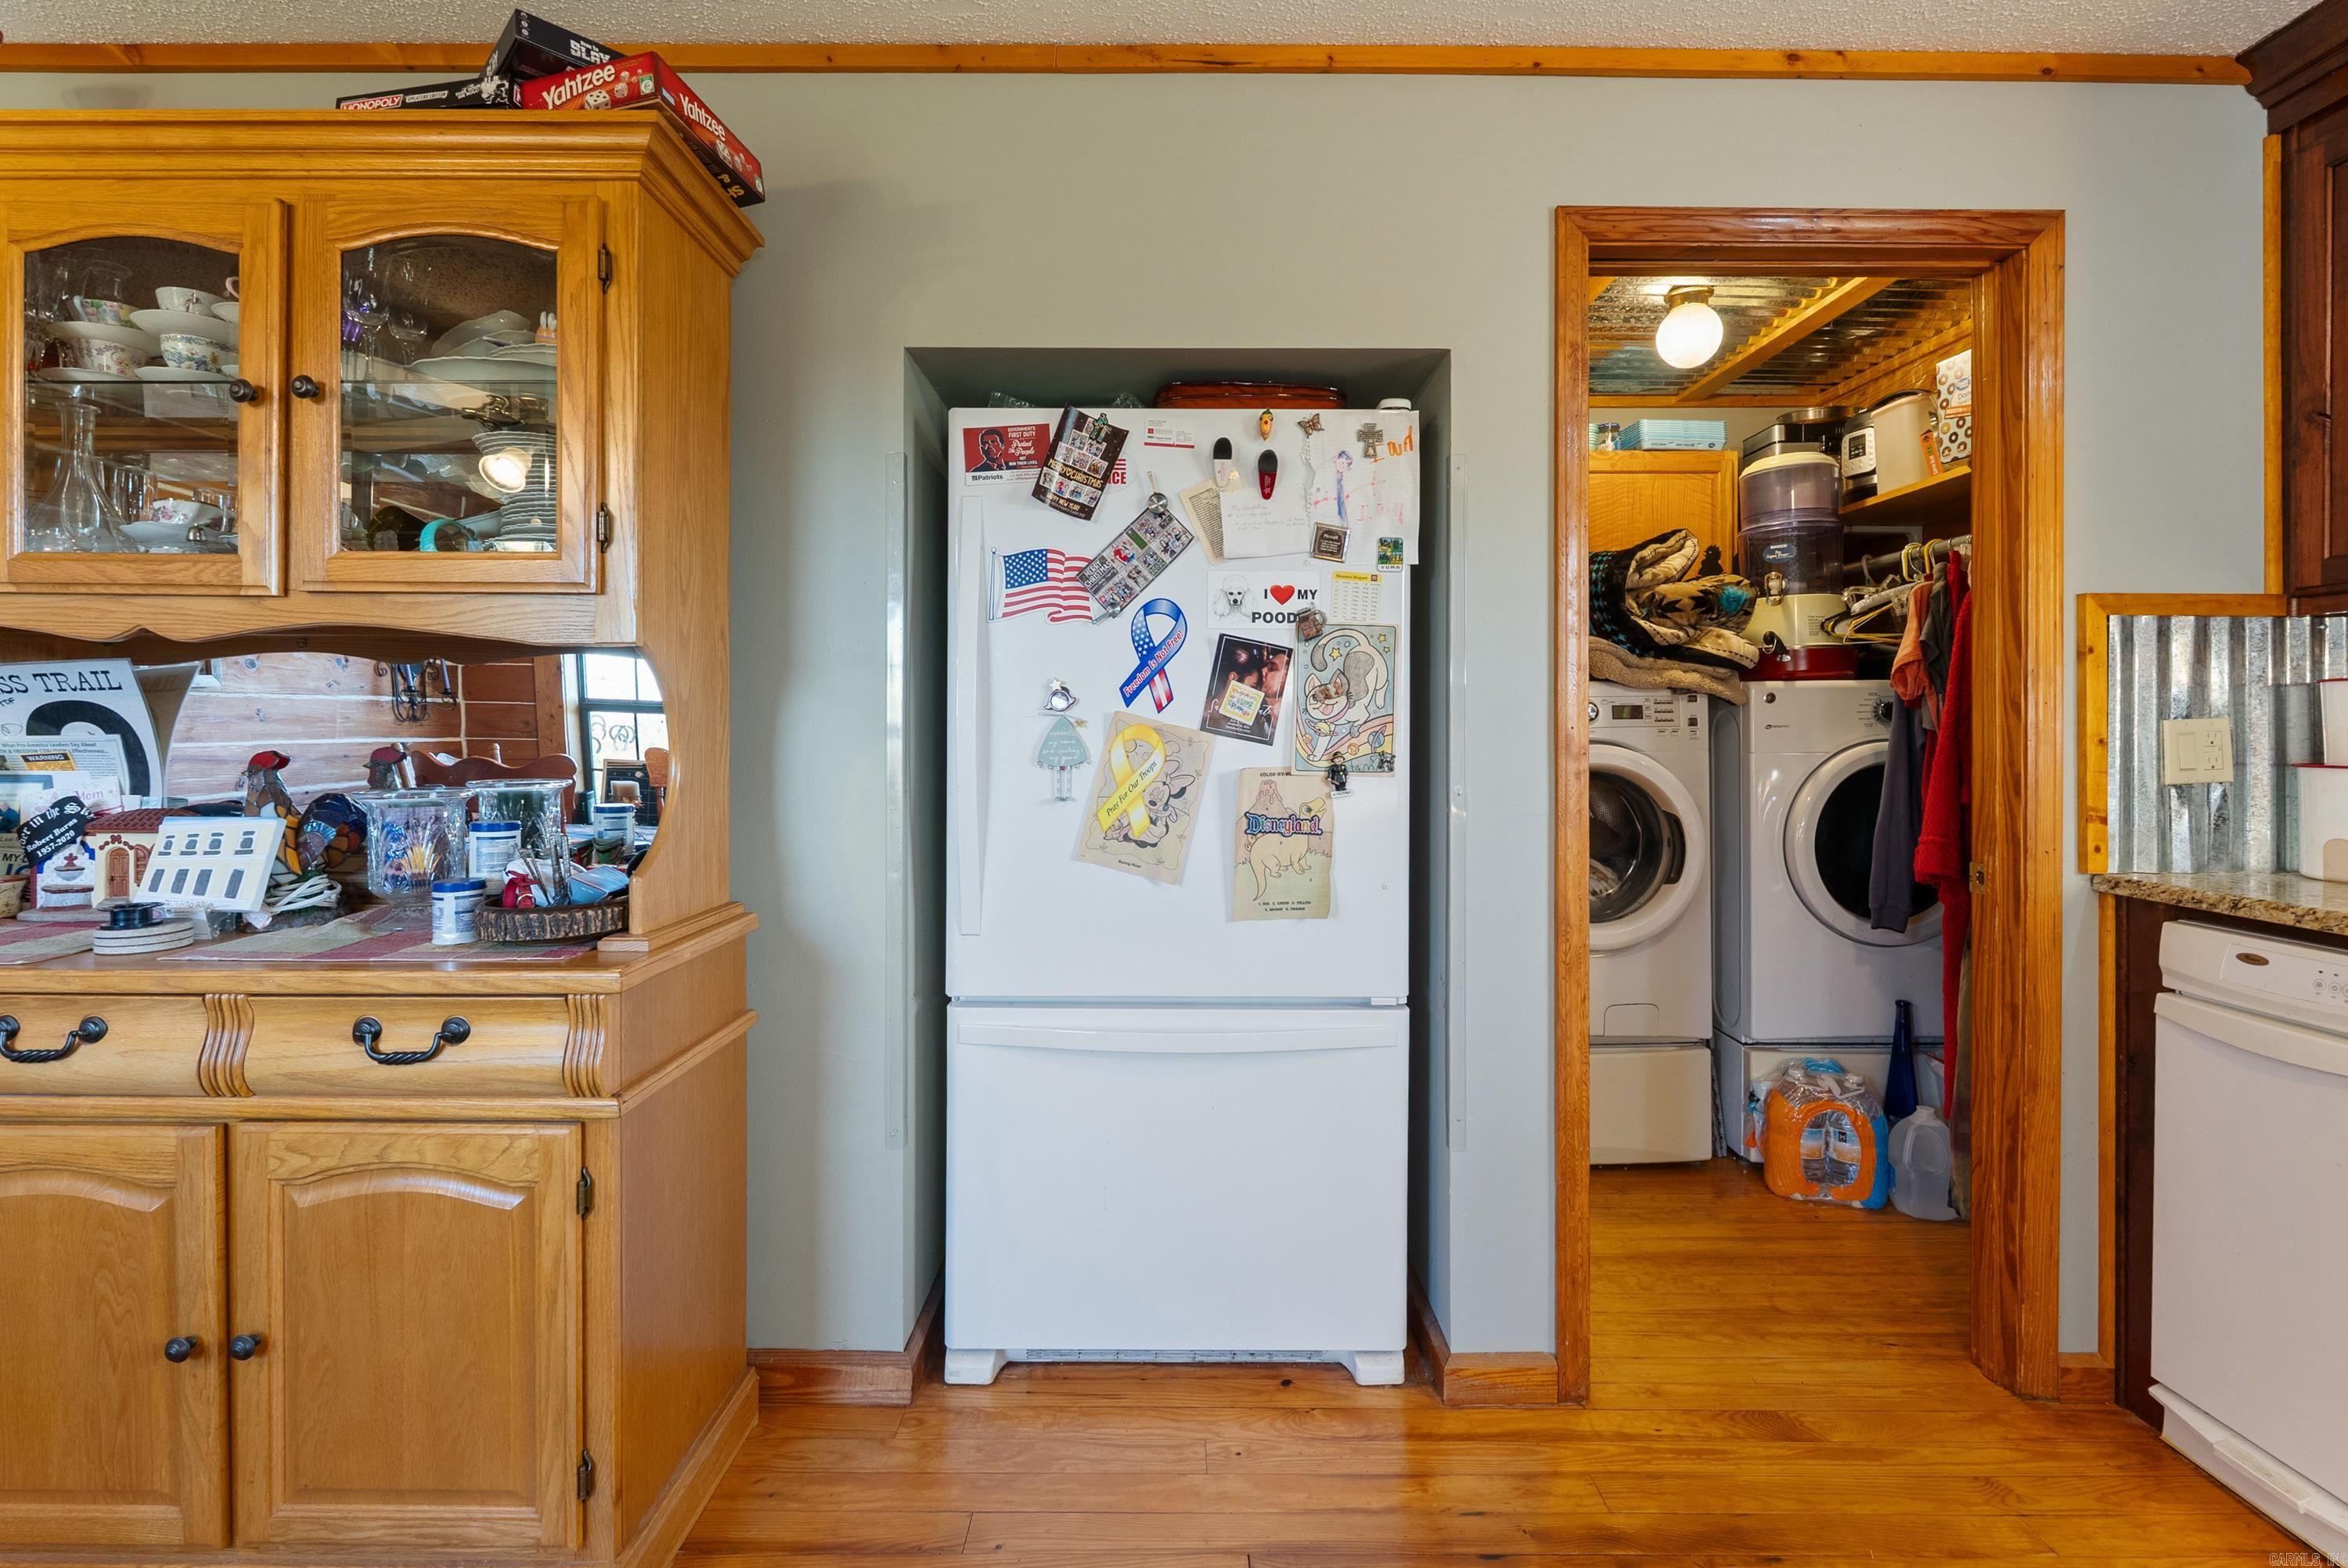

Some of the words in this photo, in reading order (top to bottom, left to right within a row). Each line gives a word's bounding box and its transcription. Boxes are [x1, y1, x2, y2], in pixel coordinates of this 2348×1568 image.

[570, 39, 610, 64] SLAY
[542, 64, 616, 110] Yahtzee
[343, 95, 400, 110] MONOPOLY
[679, 93, 726, 142] Yahtzee
[1048, 459, 1066, 474] MERRY
[1069, 470, 1104, 489] CHRISTMAS
[1084, 559, 1102, 577] MERRY
[1085, 561, 1111, 587] CHRISTMAS
[1264, 589, 1268, 599] I
[1298, 589, 1317, 599] MY
[1251, 612, 1299, 624] POOD
[1123, 666, 1151, 697] Freedom
[1148, 660, 1158, 670] Is
[1154, 646, 1169, 663] Not
[1166, 629, 1183, 650] Free!
[32, 671, 123, 692] TRAIL
[74, 789, 103, 800] Mom
[1107, 802, 1119, 817] Pray
[1118, 789, 1129, 803] For
[1128, 780, 1140, 793] Our
[1138, 761, 1157, 783] Troops
[30, 816, 44, 828] in
[46, 807, 59, 820] the
[64, 802, 96, 819] Sky
[1246, 812, 1322, 836] Disneyland
[26, 833, 54, 852] Robert
[53, 818, 78, 836] Burns
[36, 830, 75, 858] 1957-2020
